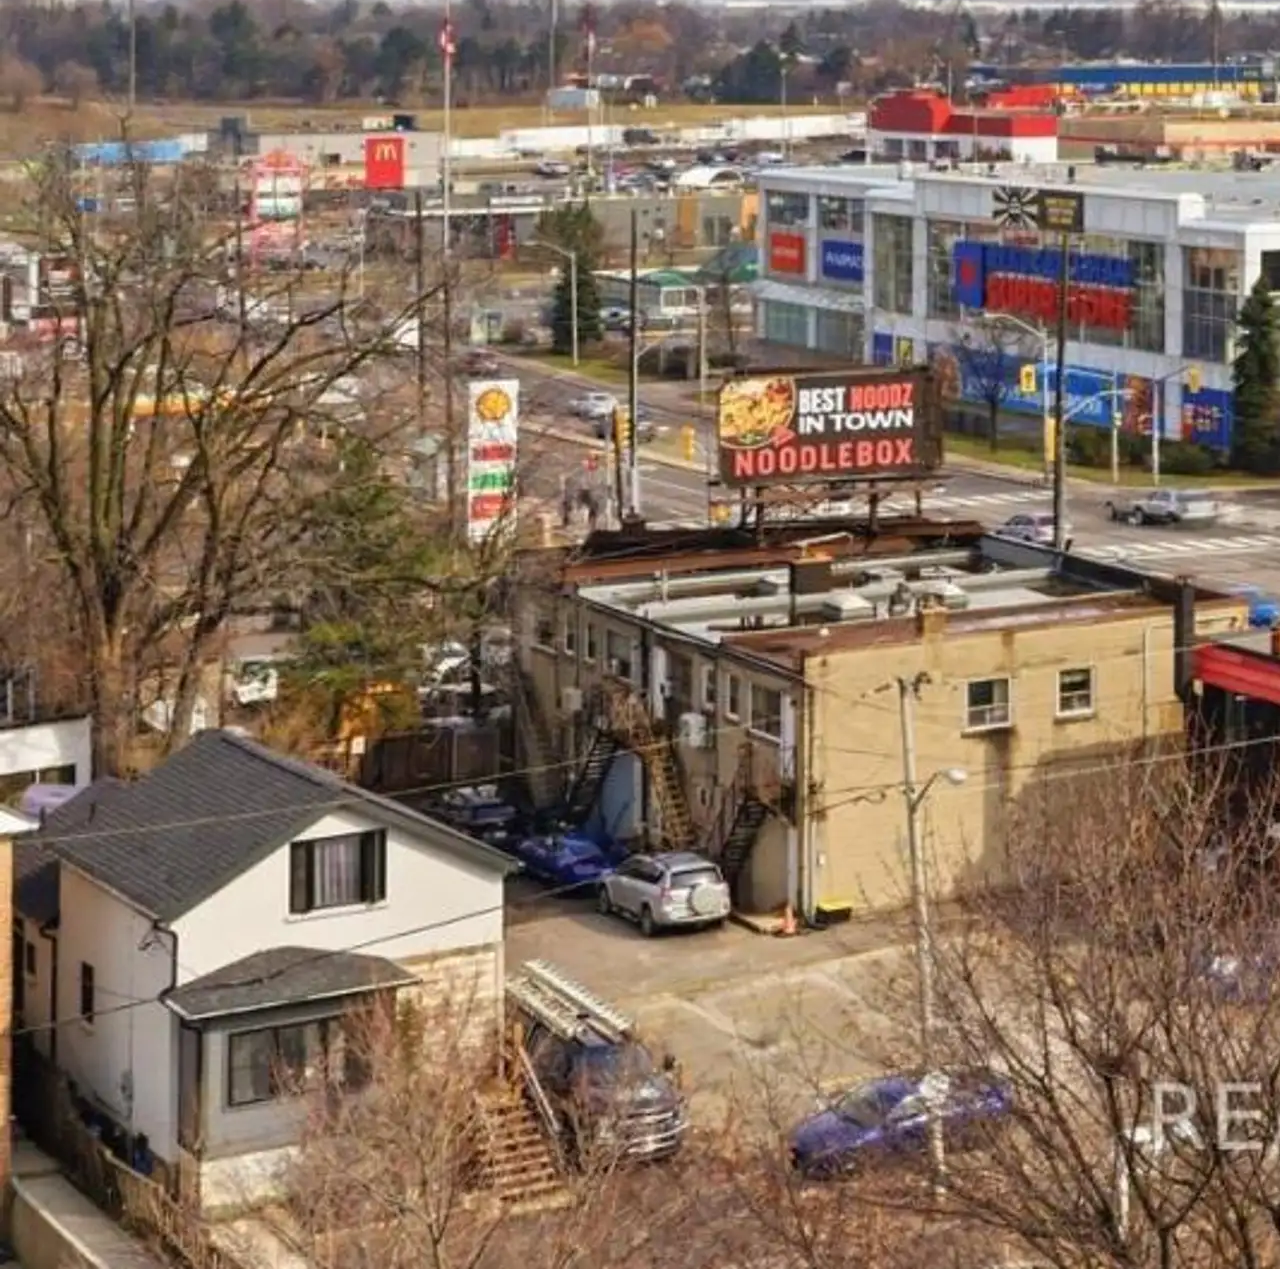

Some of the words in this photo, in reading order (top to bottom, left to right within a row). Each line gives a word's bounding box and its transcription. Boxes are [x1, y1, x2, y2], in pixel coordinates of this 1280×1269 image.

[798, 387, 846, 414] BEST
[798, 415, 825, 434] IN
[829, 408, 914, 431] TOWN
[735, 438, 913, 477] NOODLEBOX
